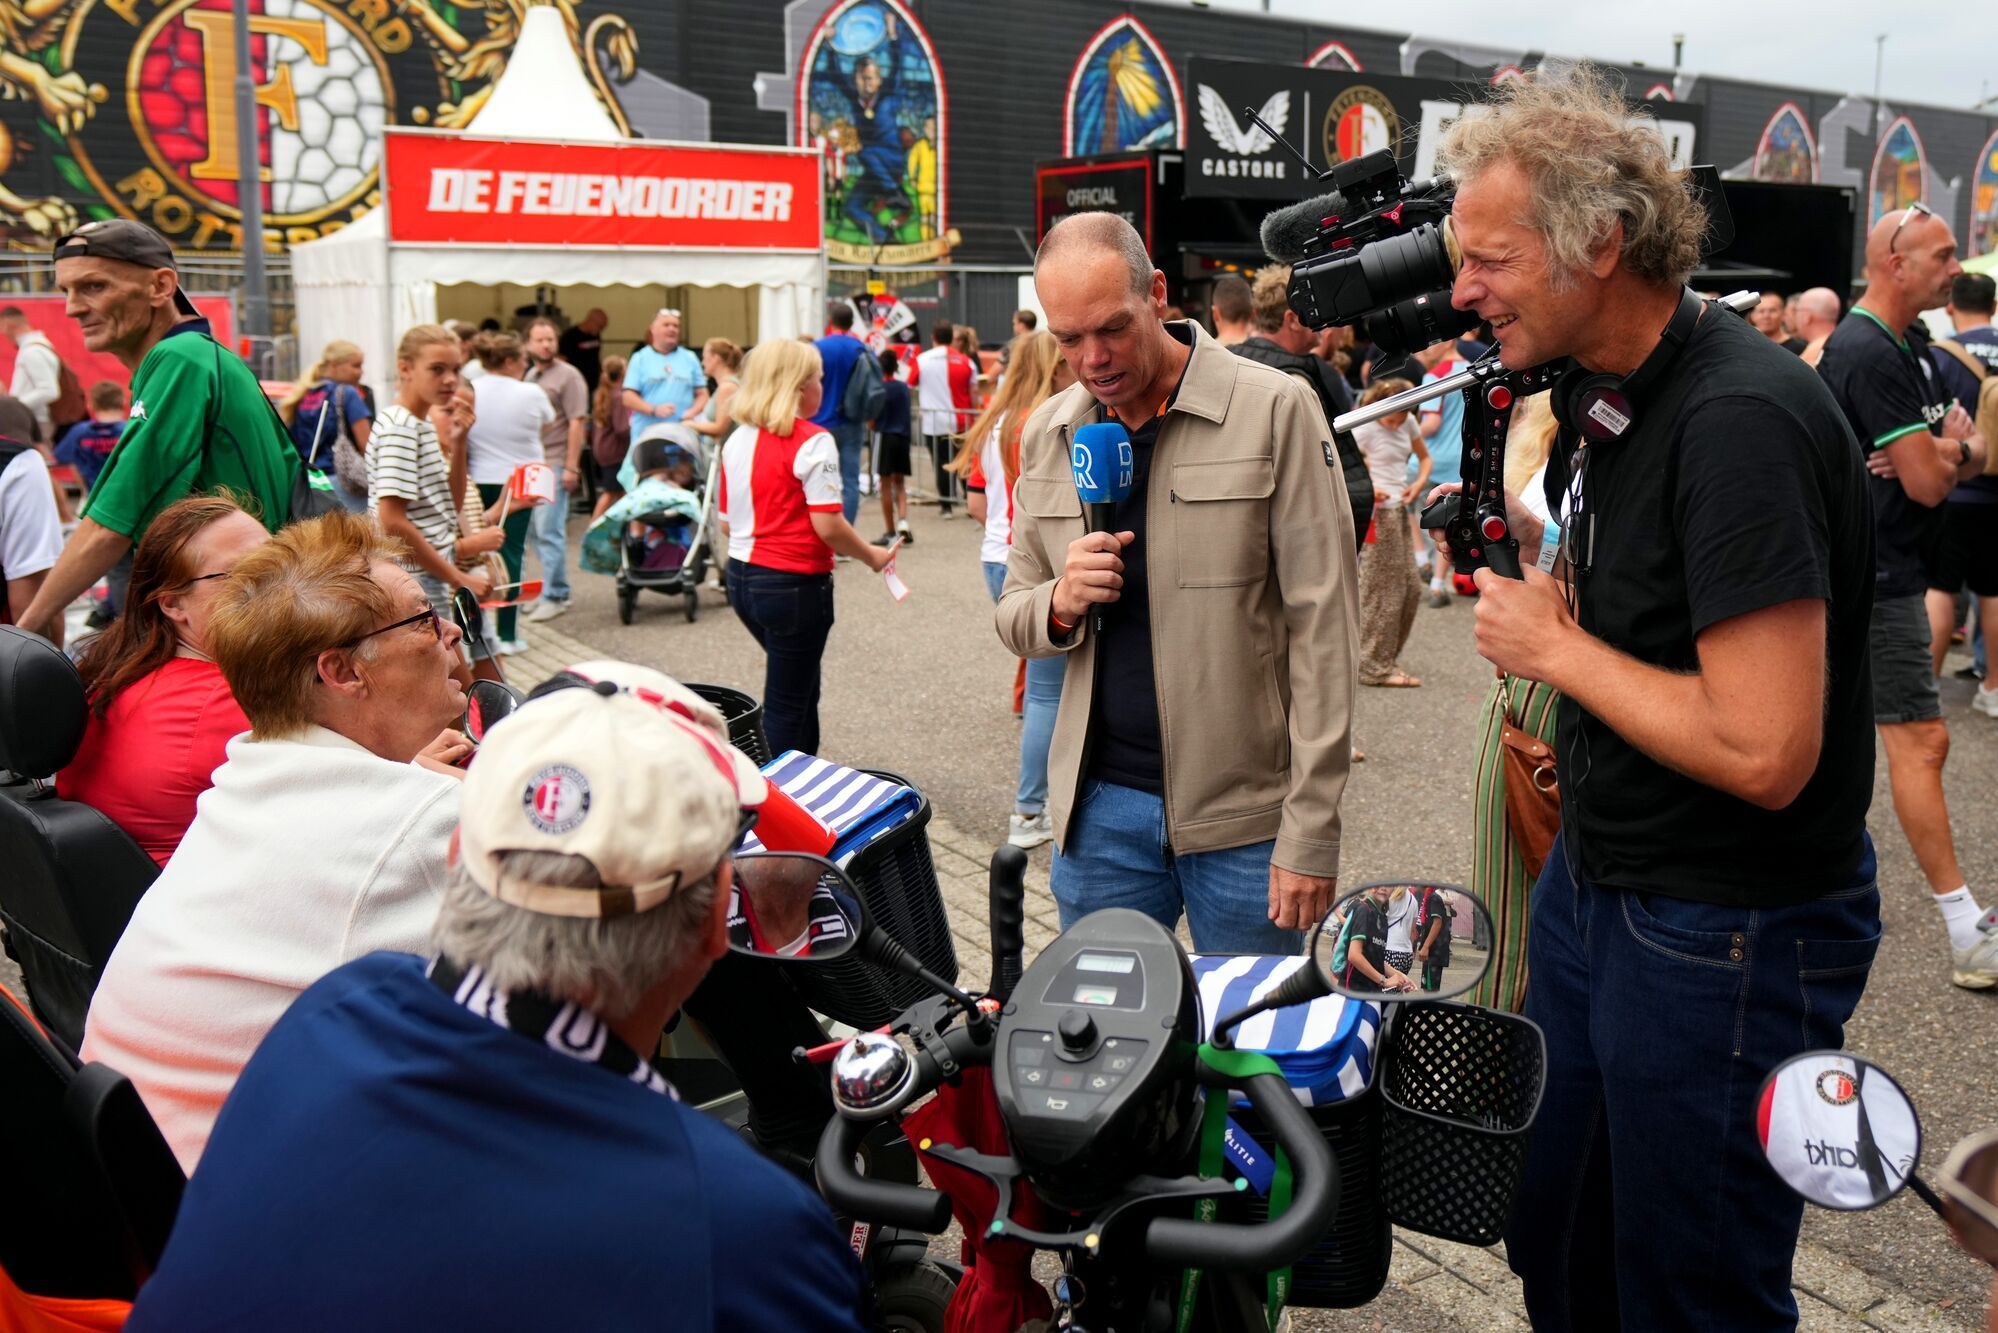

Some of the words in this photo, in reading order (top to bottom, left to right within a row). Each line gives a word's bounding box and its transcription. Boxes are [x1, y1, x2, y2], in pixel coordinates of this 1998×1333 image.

[1202, 158, 1285, 179] CASTORE
[427, 168, 493, 213] DE
[1066, 187, 1117, 207] OFFICIAL
